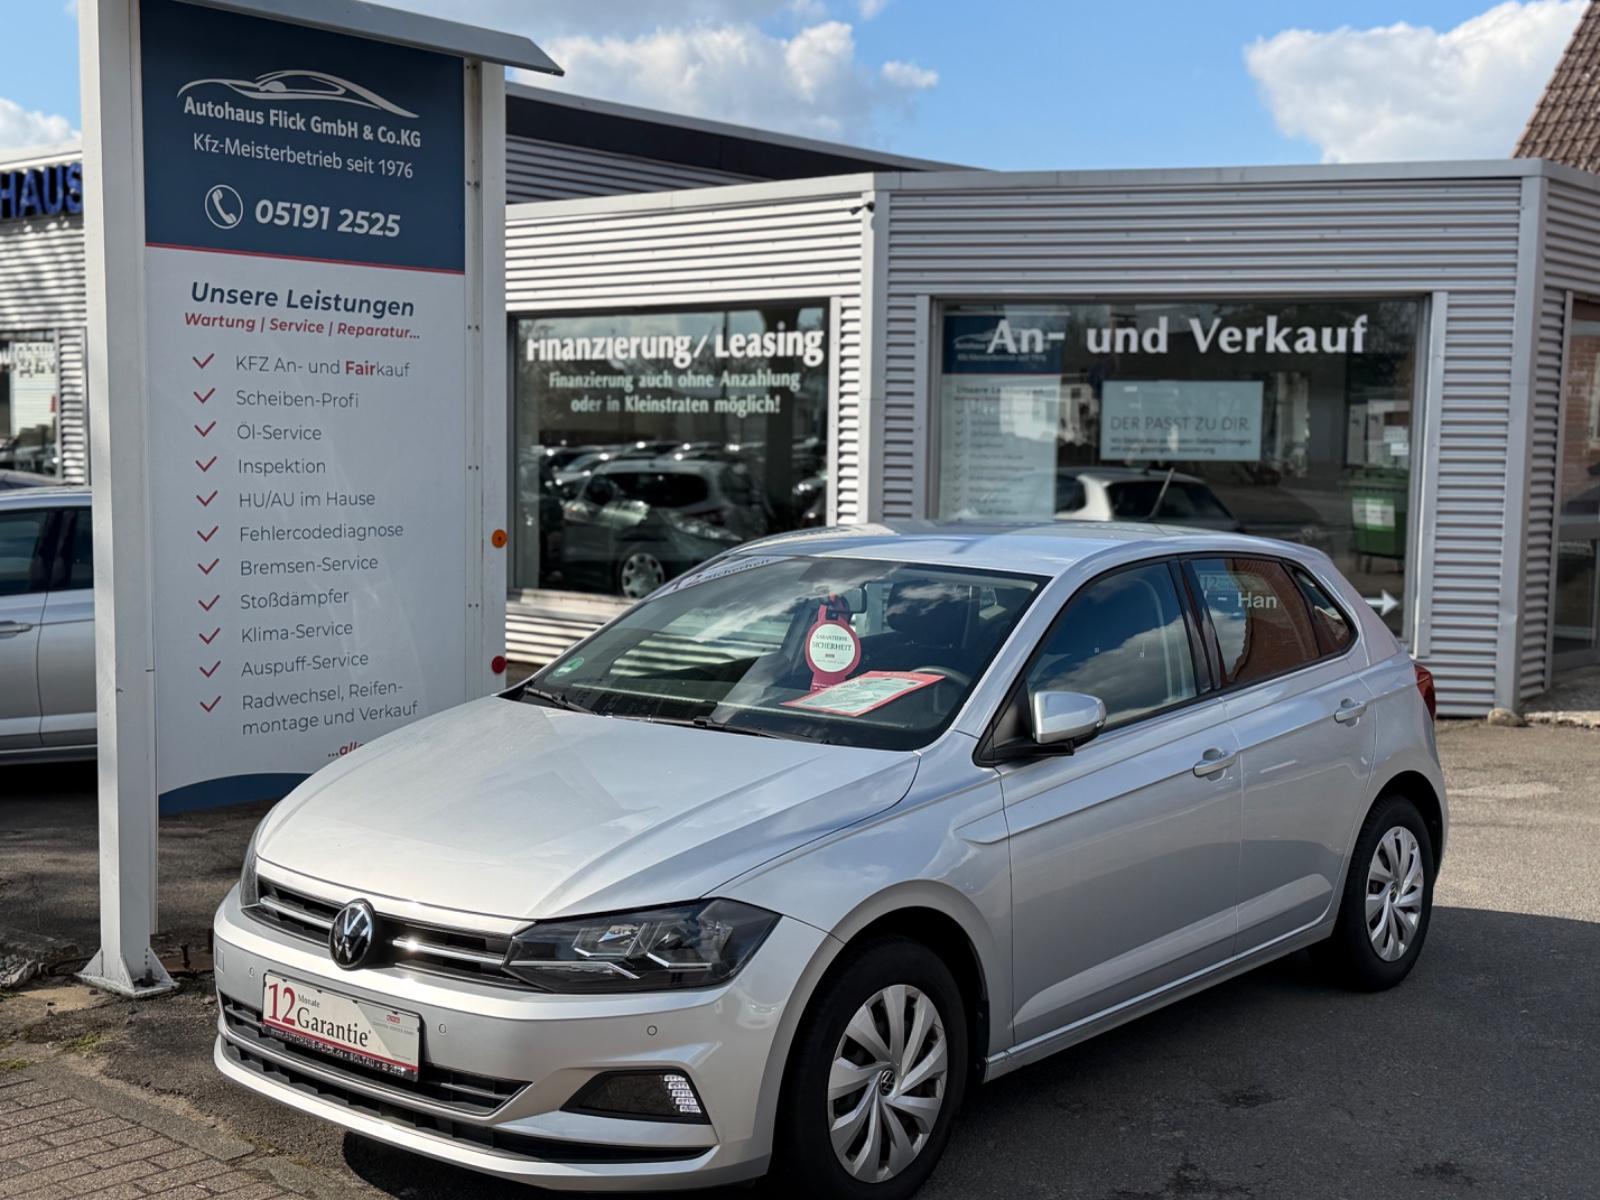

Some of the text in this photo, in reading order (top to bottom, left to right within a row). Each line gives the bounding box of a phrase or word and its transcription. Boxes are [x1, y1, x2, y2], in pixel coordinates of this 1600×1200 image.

[184, 97, 421, 149] Autohaus Flick GmbH & Co.KG
[194, 132, 413, 178] Kfz-Meisterbetrieb seit 1976
[255, 199, 401, 238] 05191 2525
[191, 282, 415, 319] Unsere Leistungen
[185, 311, 256, 333] Wartung
[270, 318, 324, 335] Service
[337, 324, 420, 342] Reparatur...
[986, 314, 1368, 354] An- und Verkauf
[235, 356, 410, 378] KFZ An- und Fairkauf
[549, 369, 801, 392] Finanzierung auch ohne Anzahlung
[235, 390, 359, 408] Scheiben-Profi
[571, 394, 781, 418] oder in Kleinstraten möglich!
[236, 421, 322, 441] Öl-Service
[1110, 416, 1140, 430] DER
[1145, 416, 1192, 430] PASST
[1195, 416, 1217, 430] ZU
[237, 458, 326, 476] Inspektion
[239, 490, 376, 508] HU/AU im Hause
[239, 522, 404, 542] Fehlercodediagnose
[240, 555, 378, 576] Bremsen-Service
[240, 588, 349, 611] Stoßdämpfer
[1237, 592, 1277, 608] Han
[241, 620, 353, 643] Klima-Service
[241, 651, 369, 679] Auspuff-Service
[242, 680, 403, 710] Radwechsel, Reifen-
[242, 701, 418, 736] montage und Verkauf
[328, 741, 365, 758] ...all
[268, 983, 296, 1026] 12
